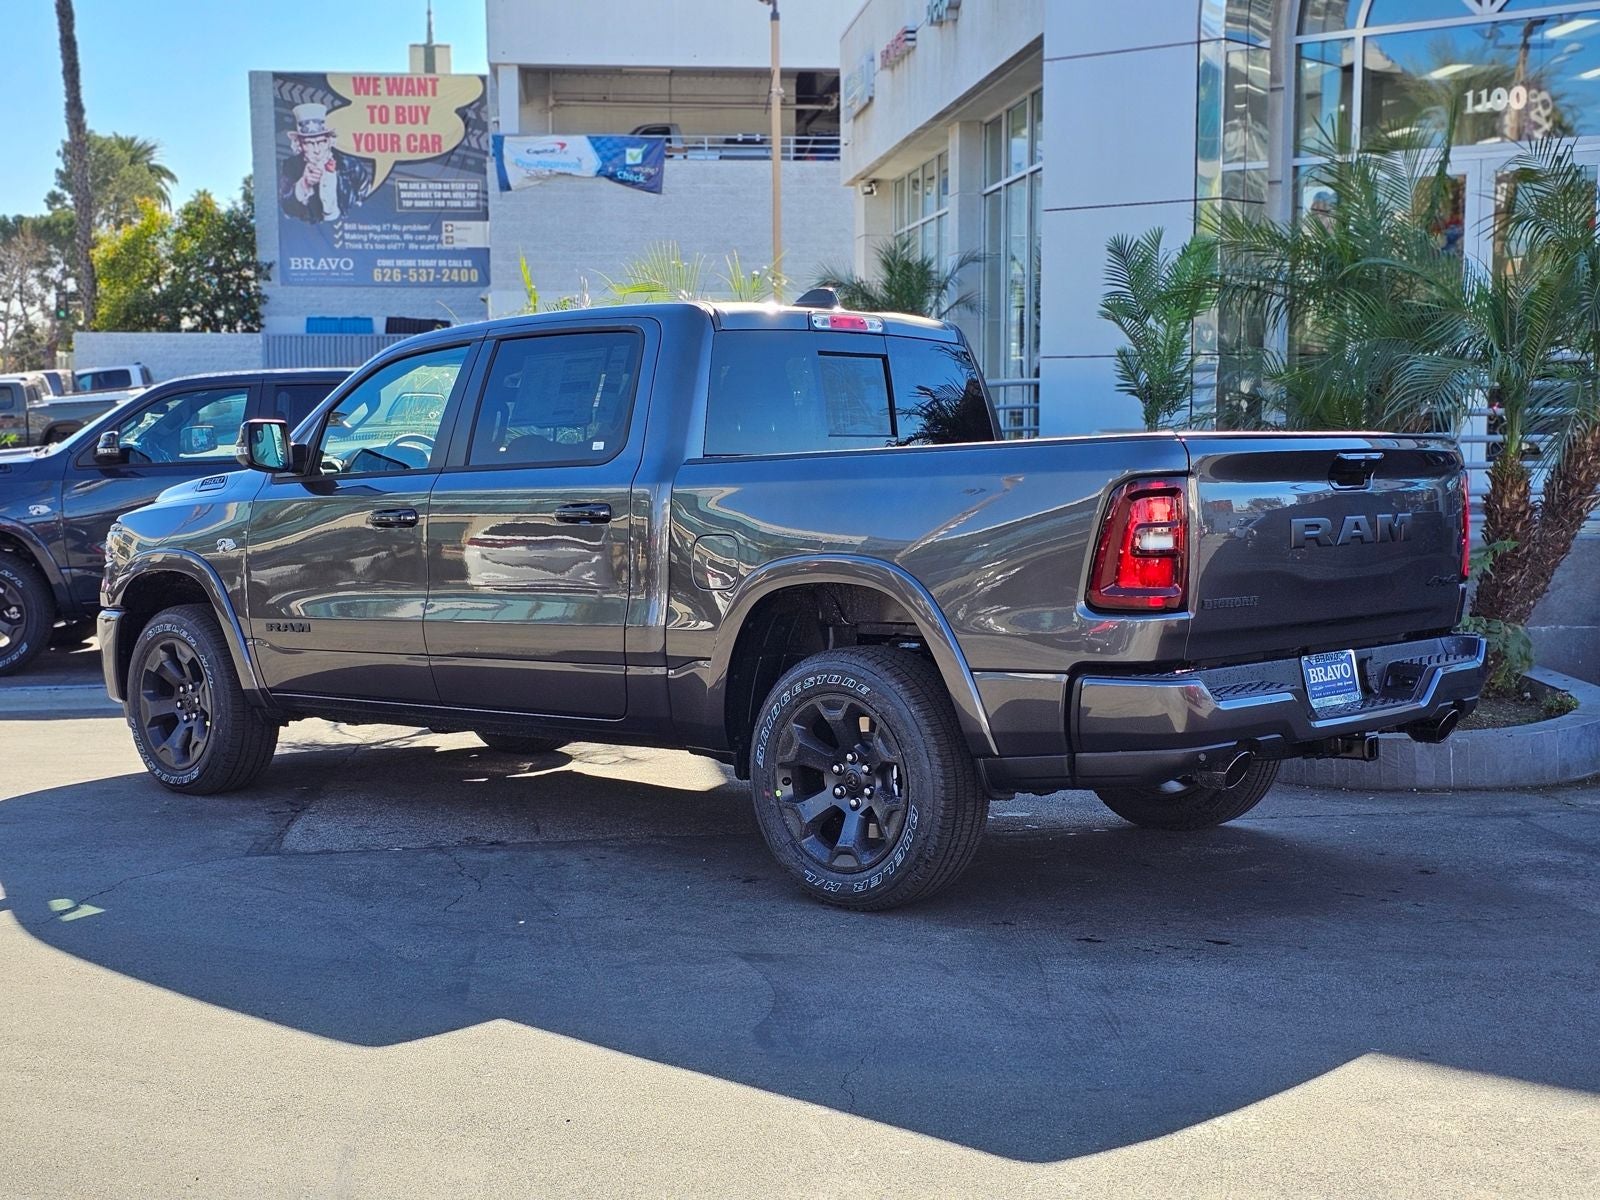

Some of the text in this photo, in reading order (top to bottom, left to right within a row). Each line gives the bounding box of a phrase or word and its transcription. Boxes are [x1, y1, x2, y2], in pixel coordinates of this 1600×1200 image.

[352, 76, 439, 97] WE WANT
[1463, 86, 1528, 114] 1100
[366, 105, 431, 125] TO BUY
[352, 133, 442, 153] YOUR CAR
[344, 233, 367, 242] Making
[290, 257, 354, 271] BRAVO
[374, 268, 478, 282] 626-537-2400
[204, 477, 224, 485] 1500
[1290, 512, 1413, 549] RAM
[266, 623, 311, 632] RAM
[1308, 663, 1351, 683] BRAVO
[756, 674, 870, 768] BRIDGESTONE
[804, 805, 919, 893] DUELER H/L
